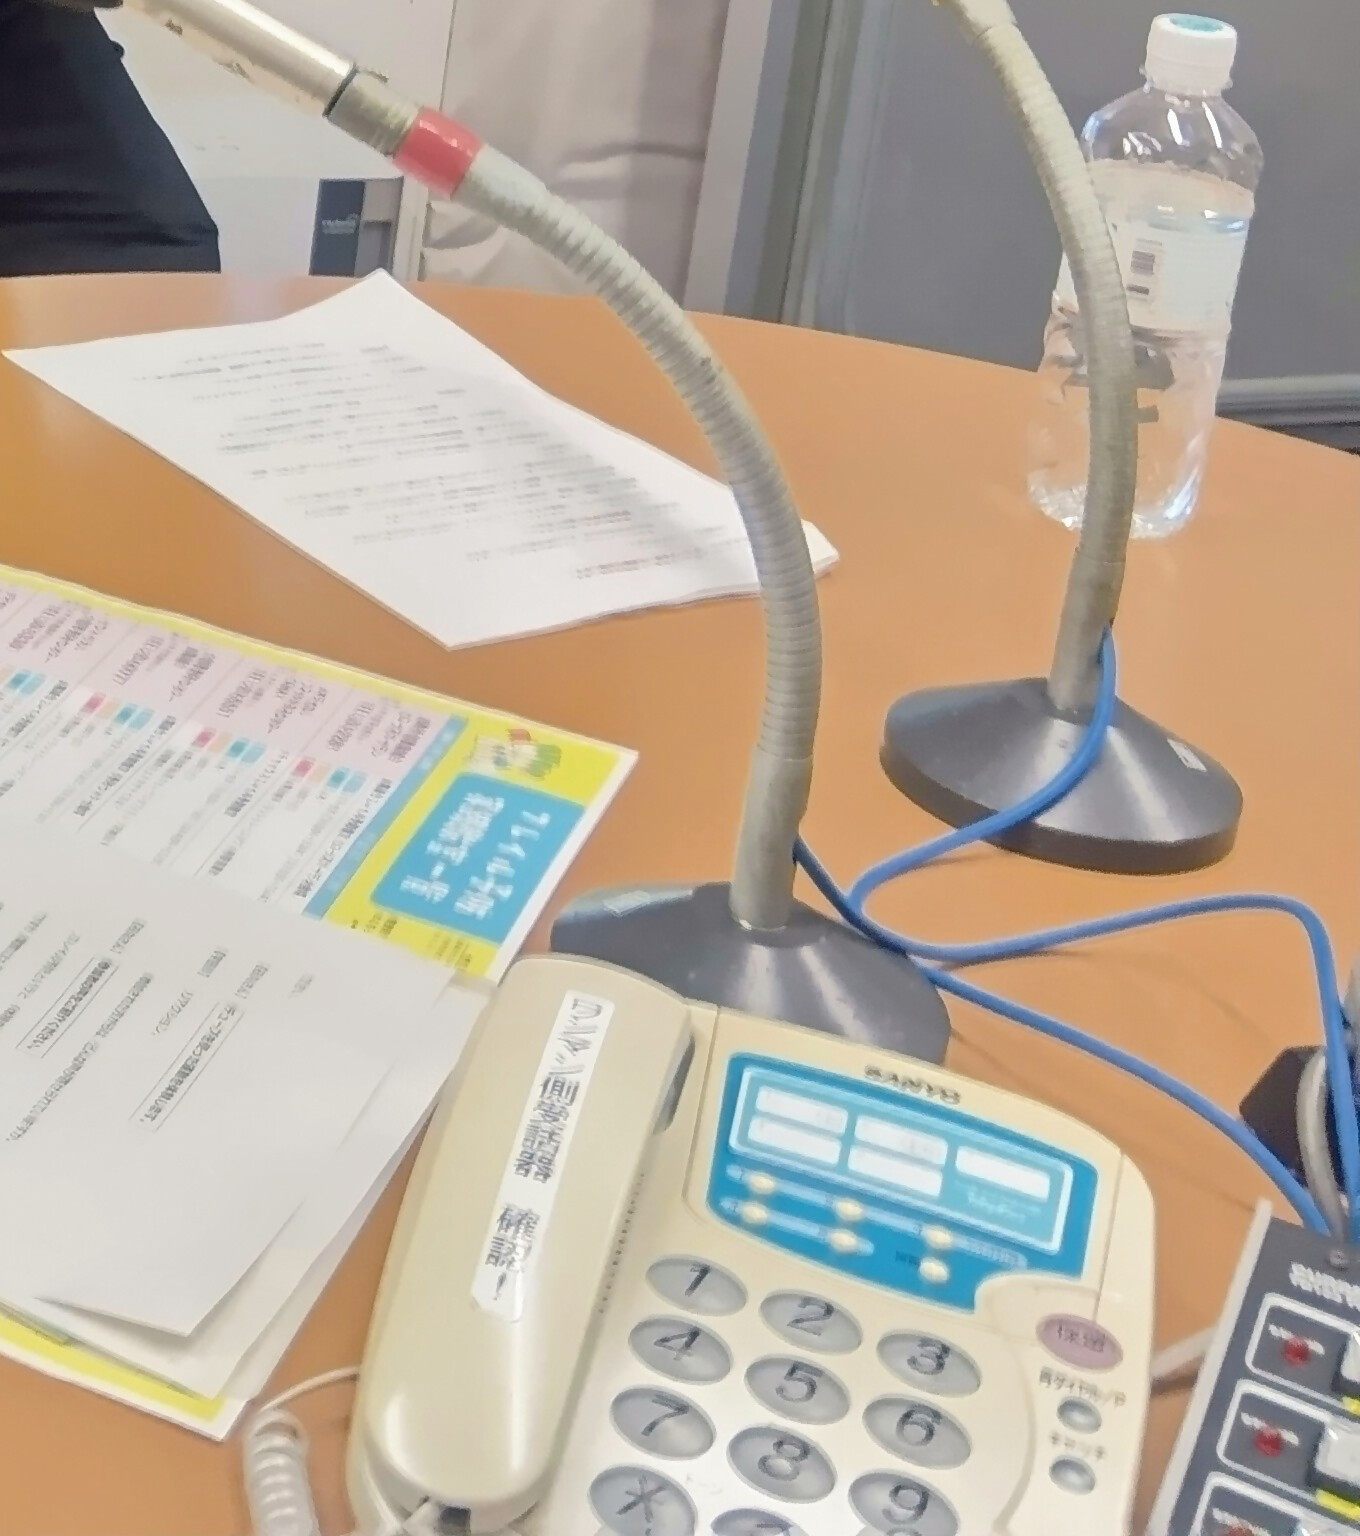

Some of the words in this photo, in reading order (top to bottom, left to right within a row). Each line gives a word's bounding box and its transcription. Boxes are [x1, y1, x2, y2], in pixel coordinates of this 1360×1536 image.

[863, 1064, 961, 1106] SANYO
[684, 1264, 711, 1297] 1
[787, 1296, 835, 1337] 2
[653, 1326, 702, 1363] 4
[906, 1336, 951, 1377] 3
[774, 1361, 824, 1405] 5
[641, 1393, 690, 1438] 7
[895, 1402, 942, 1448] 6
[756, 1437, 811, 1482] 8
[882, 1481, 930, 1526] 9
